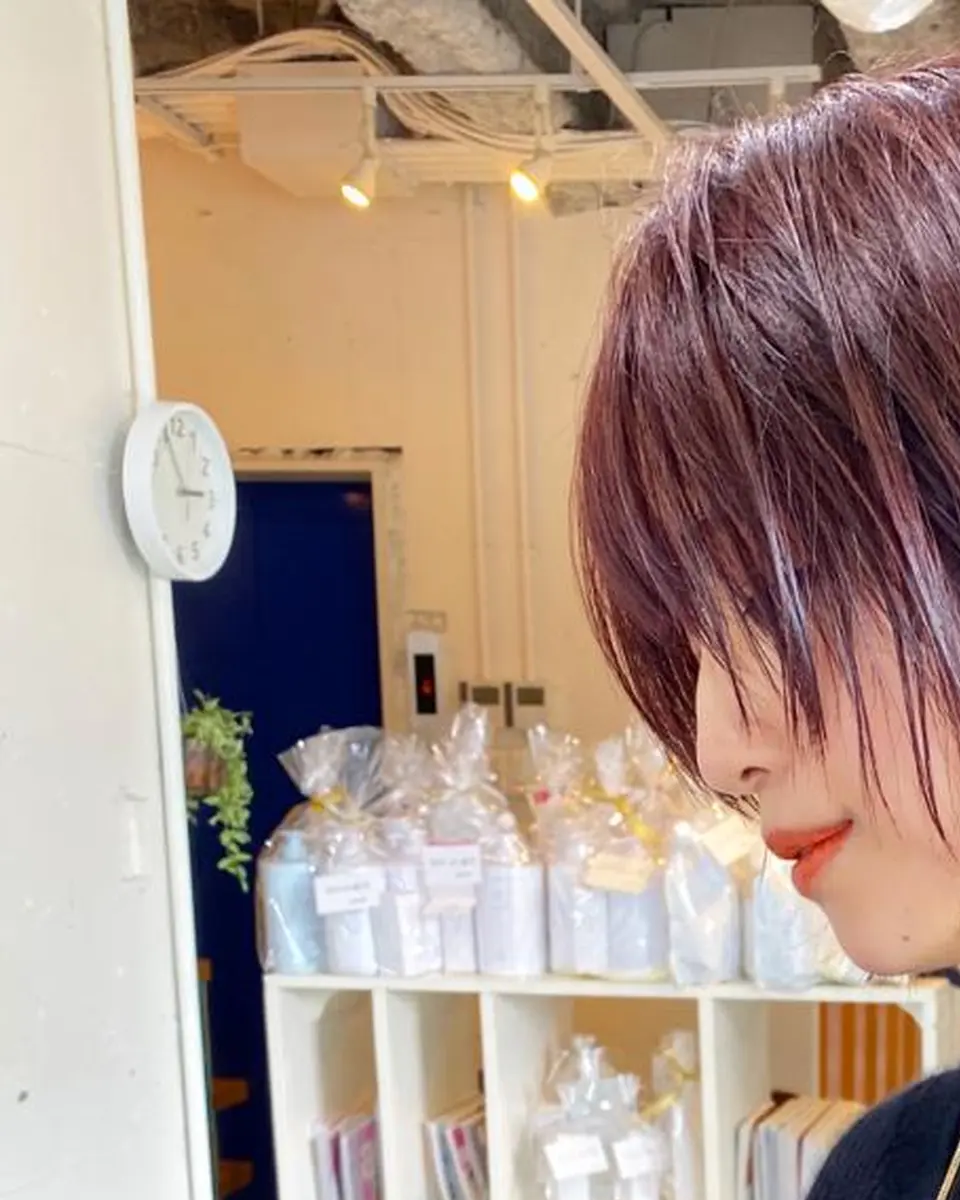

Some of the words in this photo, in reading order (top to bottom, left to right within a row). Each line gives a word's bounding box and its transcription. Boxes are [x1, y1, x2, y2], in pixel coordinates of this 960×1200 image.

[170, 417, 187, 438] 12
[201, 456, 211, 477] 2
[191, 540, 200, 561] 5
